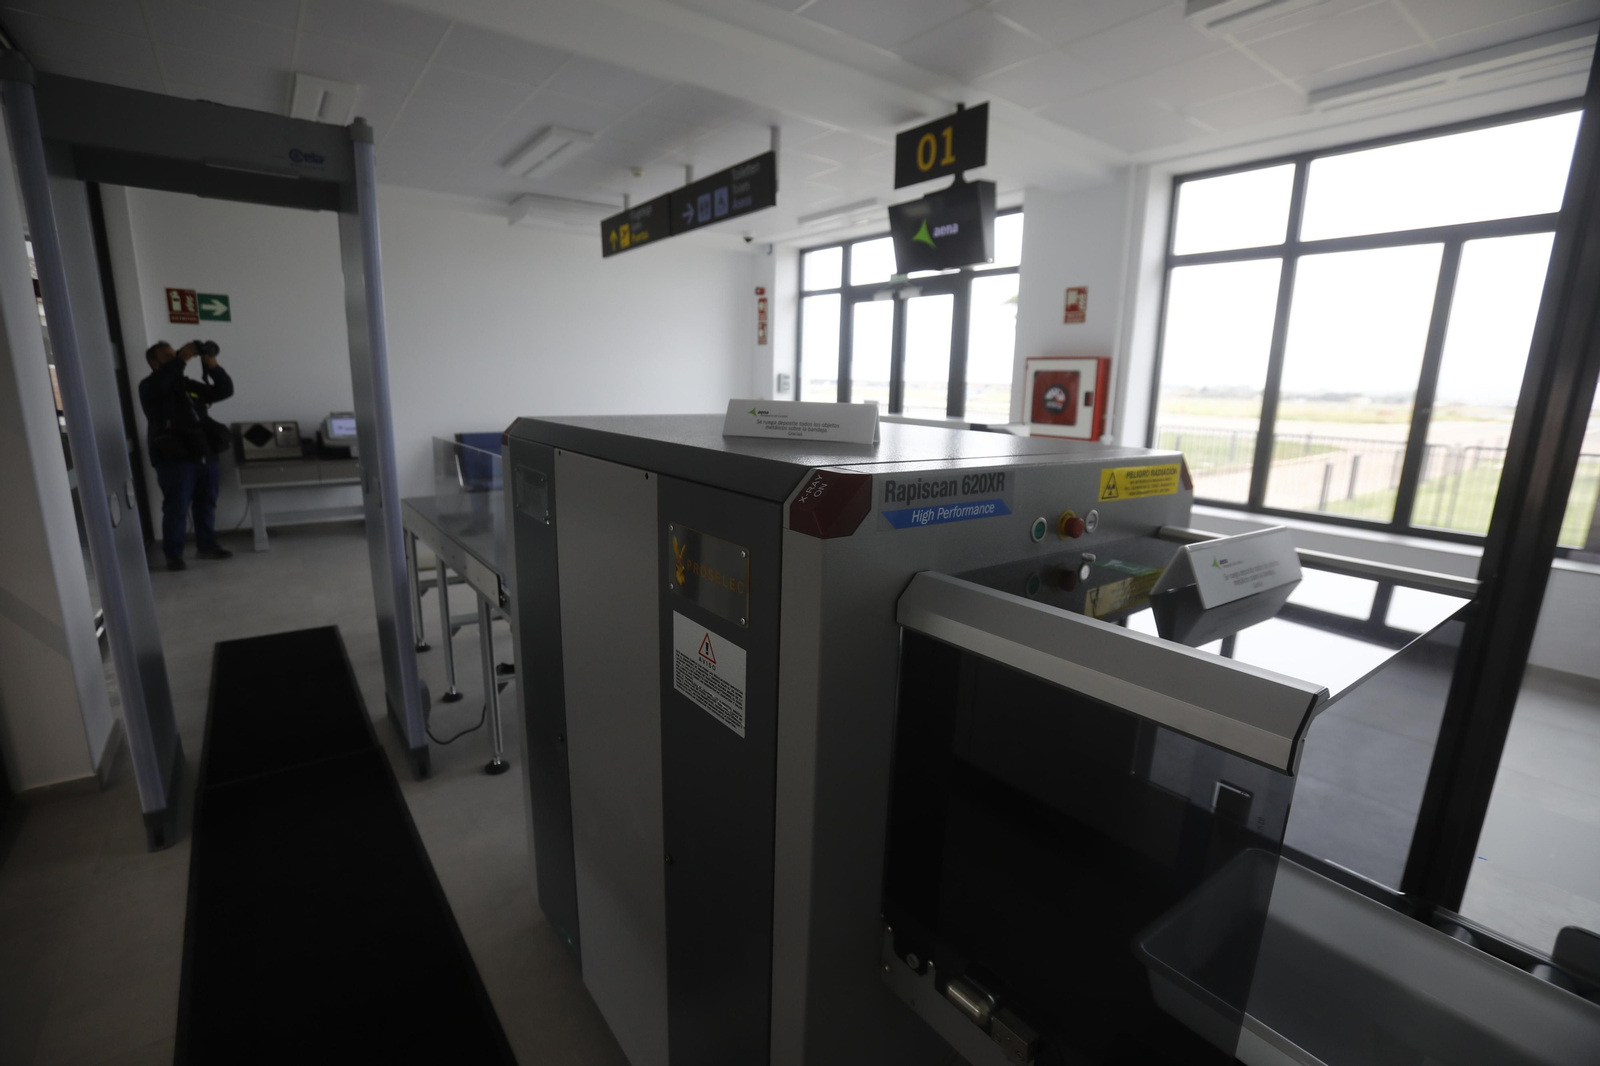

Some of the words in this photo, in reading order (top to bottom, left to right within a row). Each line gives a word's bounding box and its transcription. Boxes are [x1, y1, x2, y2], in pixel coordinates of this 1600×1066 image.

[916, 126, 956, 172] 01
[933, 222, 959, 238] aena
[1126, 470, 1150, 478] PELIGRO
[798, 474, 824, 503] X-RAY
[813, 482, 828, 497] ON
[884, 477, 957, 505] Rapiscan
[961, 472, 1006, 495] 620XR
[911, 509, 935, 525] High
[937, 503, 995, 520] Performance
[686, 559, 744, 594] PROSELEC
[699, 656, 717, 671] AVISO
